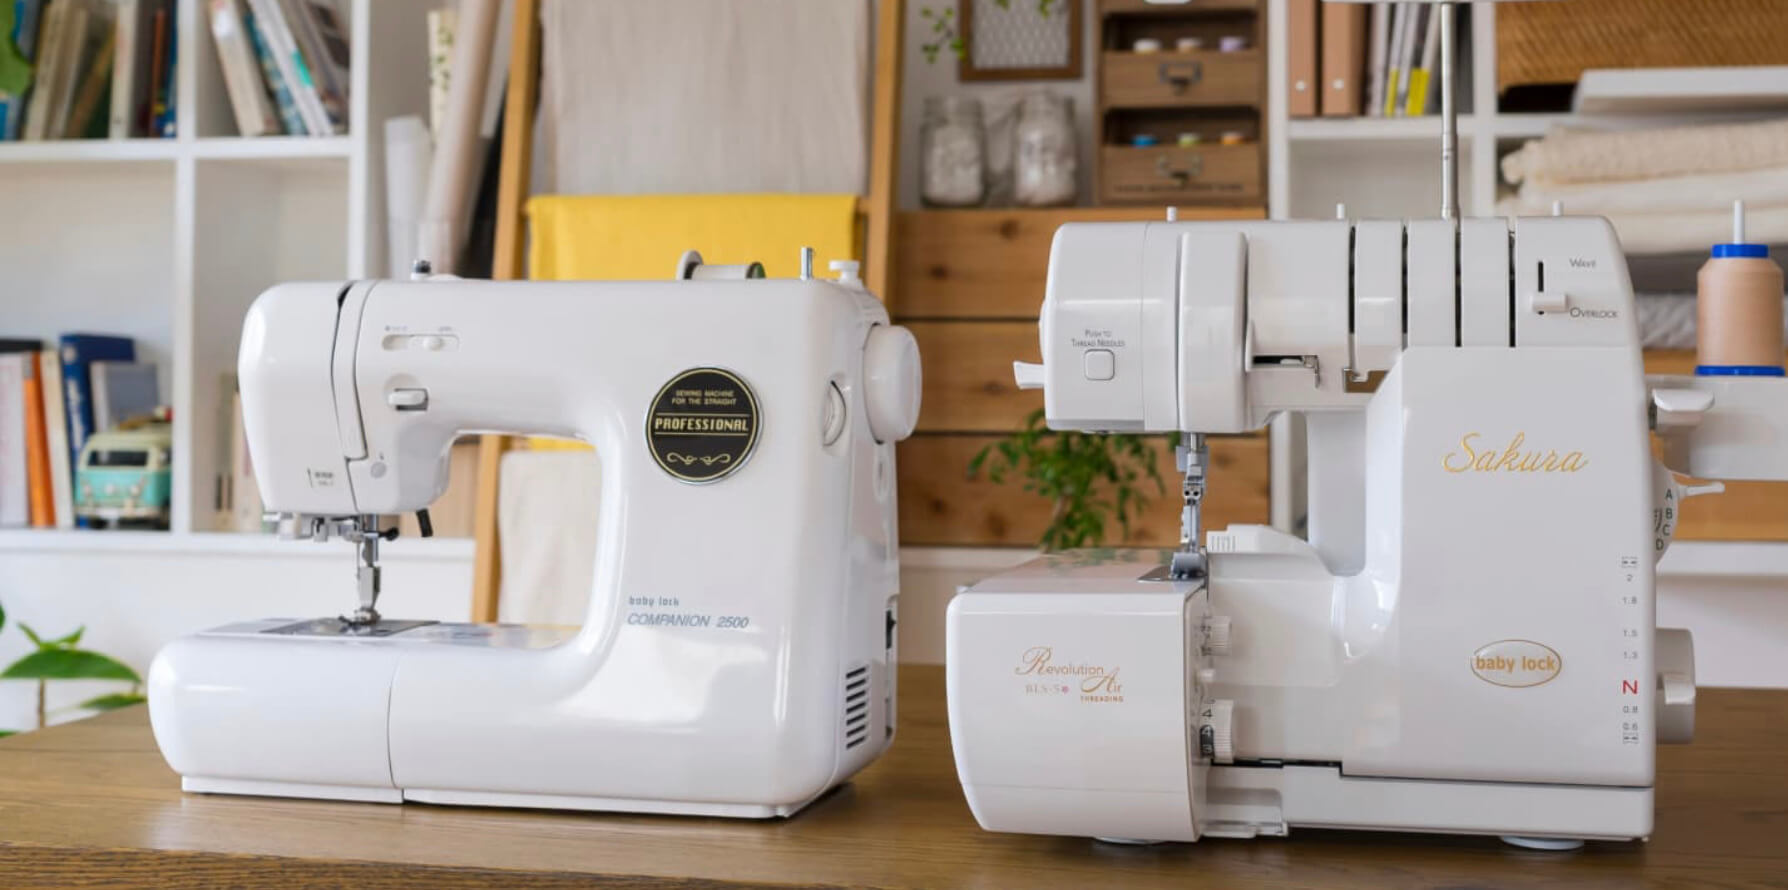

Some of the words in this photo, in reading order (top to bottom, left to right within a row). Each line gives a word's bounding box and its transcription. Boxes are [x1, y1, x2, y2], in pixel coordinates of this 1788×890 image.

[1569, 306, 1618, 319] OVERLOCK
[671, 397, 686, 405] FOR
[688, 397, 701, 405] THE
[655, 417, 748, 431] PROFESSIONAL
[1442, 431, 1590, 473] Sakura
[1665, 489, 1673, 500] A
[1665, 507, 1673, 520] B
[1662, 523, 1671, 536] C
[1655, 538, 1664, 551] D
[629, 595, 654, 607] baby
[659, 596, 680, 607] lock
[627, 613, 711, 628] COMPANION
[716, 616, 750, 629] 2500
[1015, 646, 1105, 676] Revolution
[1475, 655, 1515, 674] baby
[1522, 655, 1556, 671] lock
[1080, 667, 1122, 694] Air
[1622, 679, 1638, 695] N
[1080, 695, 1125, 703] THREADING
